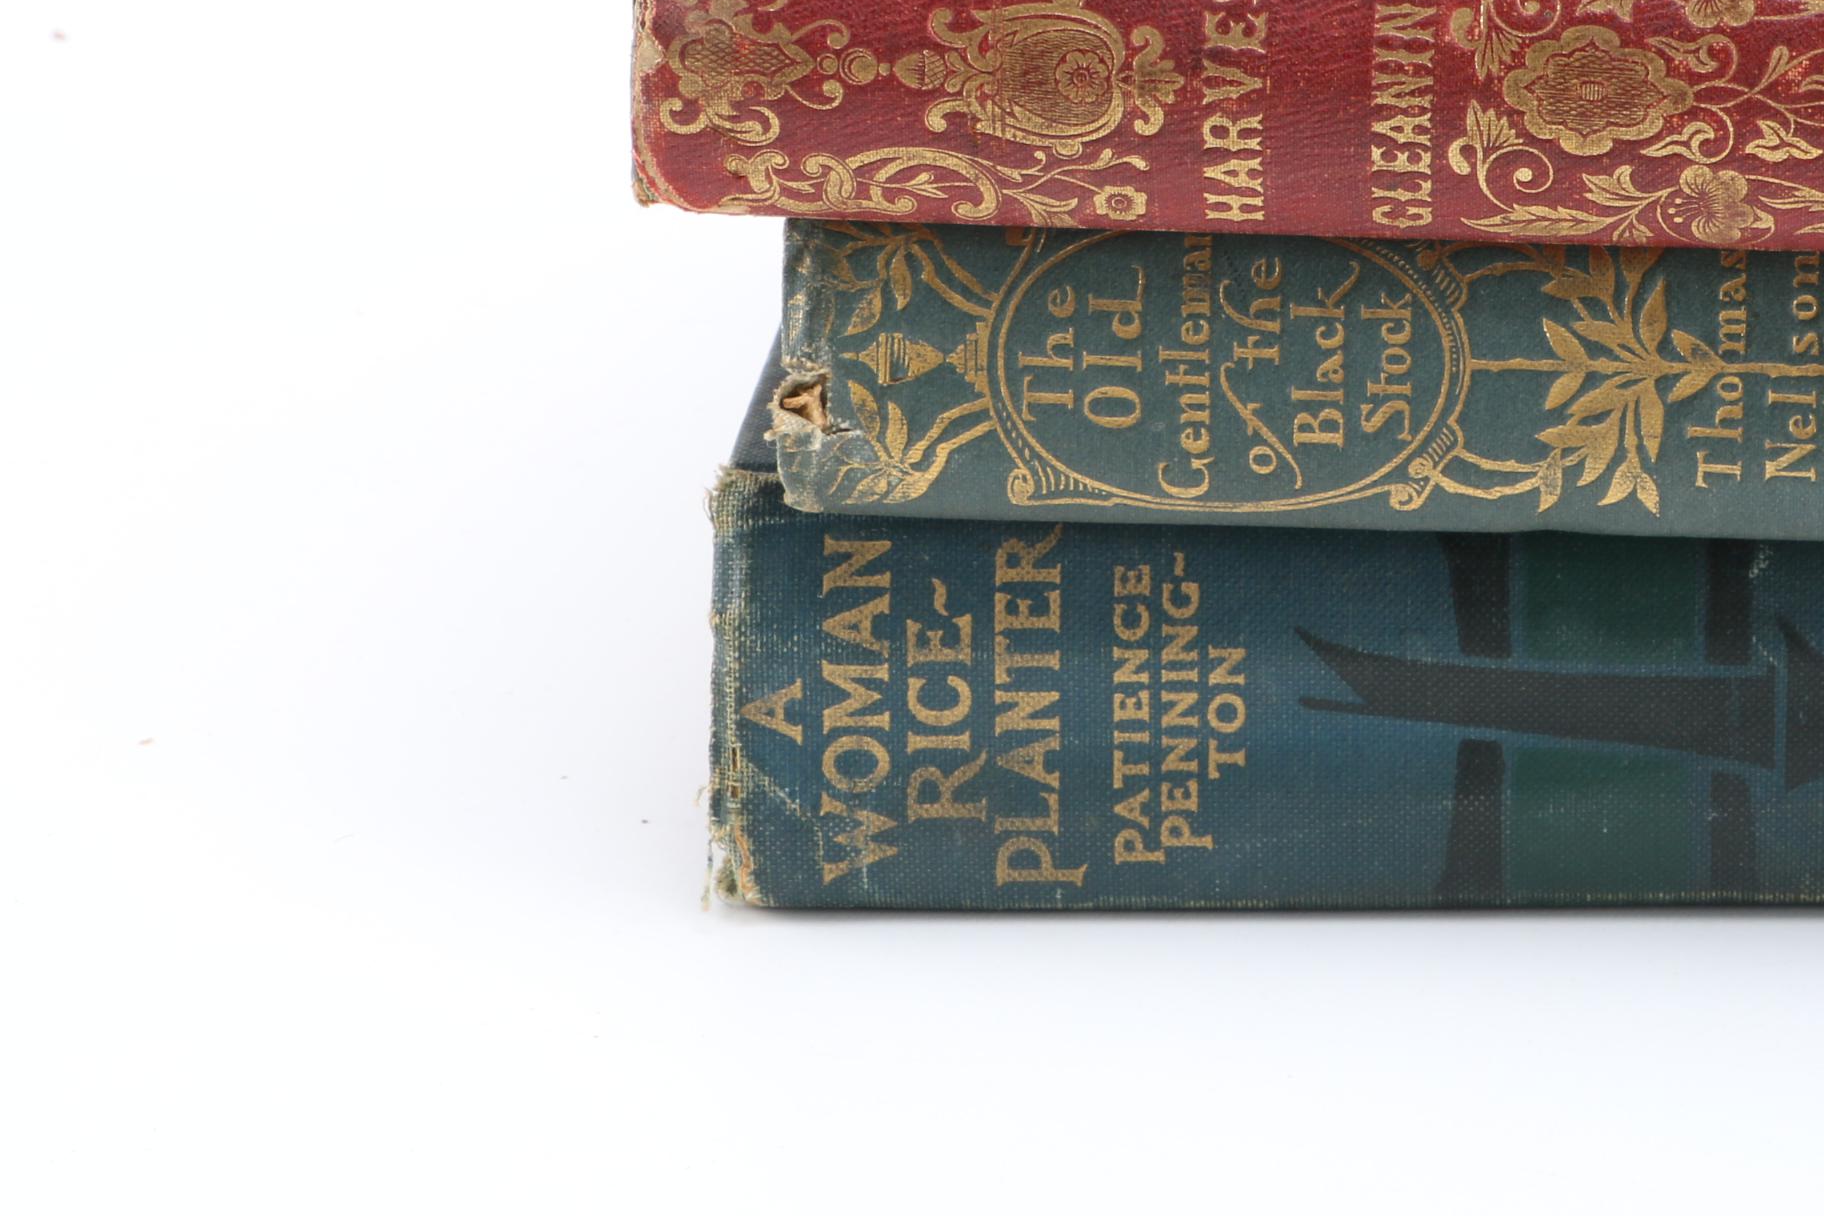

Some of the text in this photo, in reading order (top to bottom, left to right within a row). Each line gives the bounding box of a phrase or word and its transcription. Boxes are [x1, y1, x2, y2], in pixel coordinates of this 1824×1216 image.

[1019, 284, 1076, 420] The
[1082, 264, 1146, 429] Old
[1219, 256, 1302, 489] of the
[1289, 261, 1361, 446] Black
[1360, 291, 1413, 441] Stock
[1687, 250, 1748, 488] Thomas
[1764, 252, 1821, 481] Nelson
[739, 677, 804, 745] A
[820, 533, 899, 886] WOMAN
[994, 522, 1087, 888] PLANTER
[1112, 563, 1167, 865] PATIENCE
[1207, 643, 1247, 779] TON
